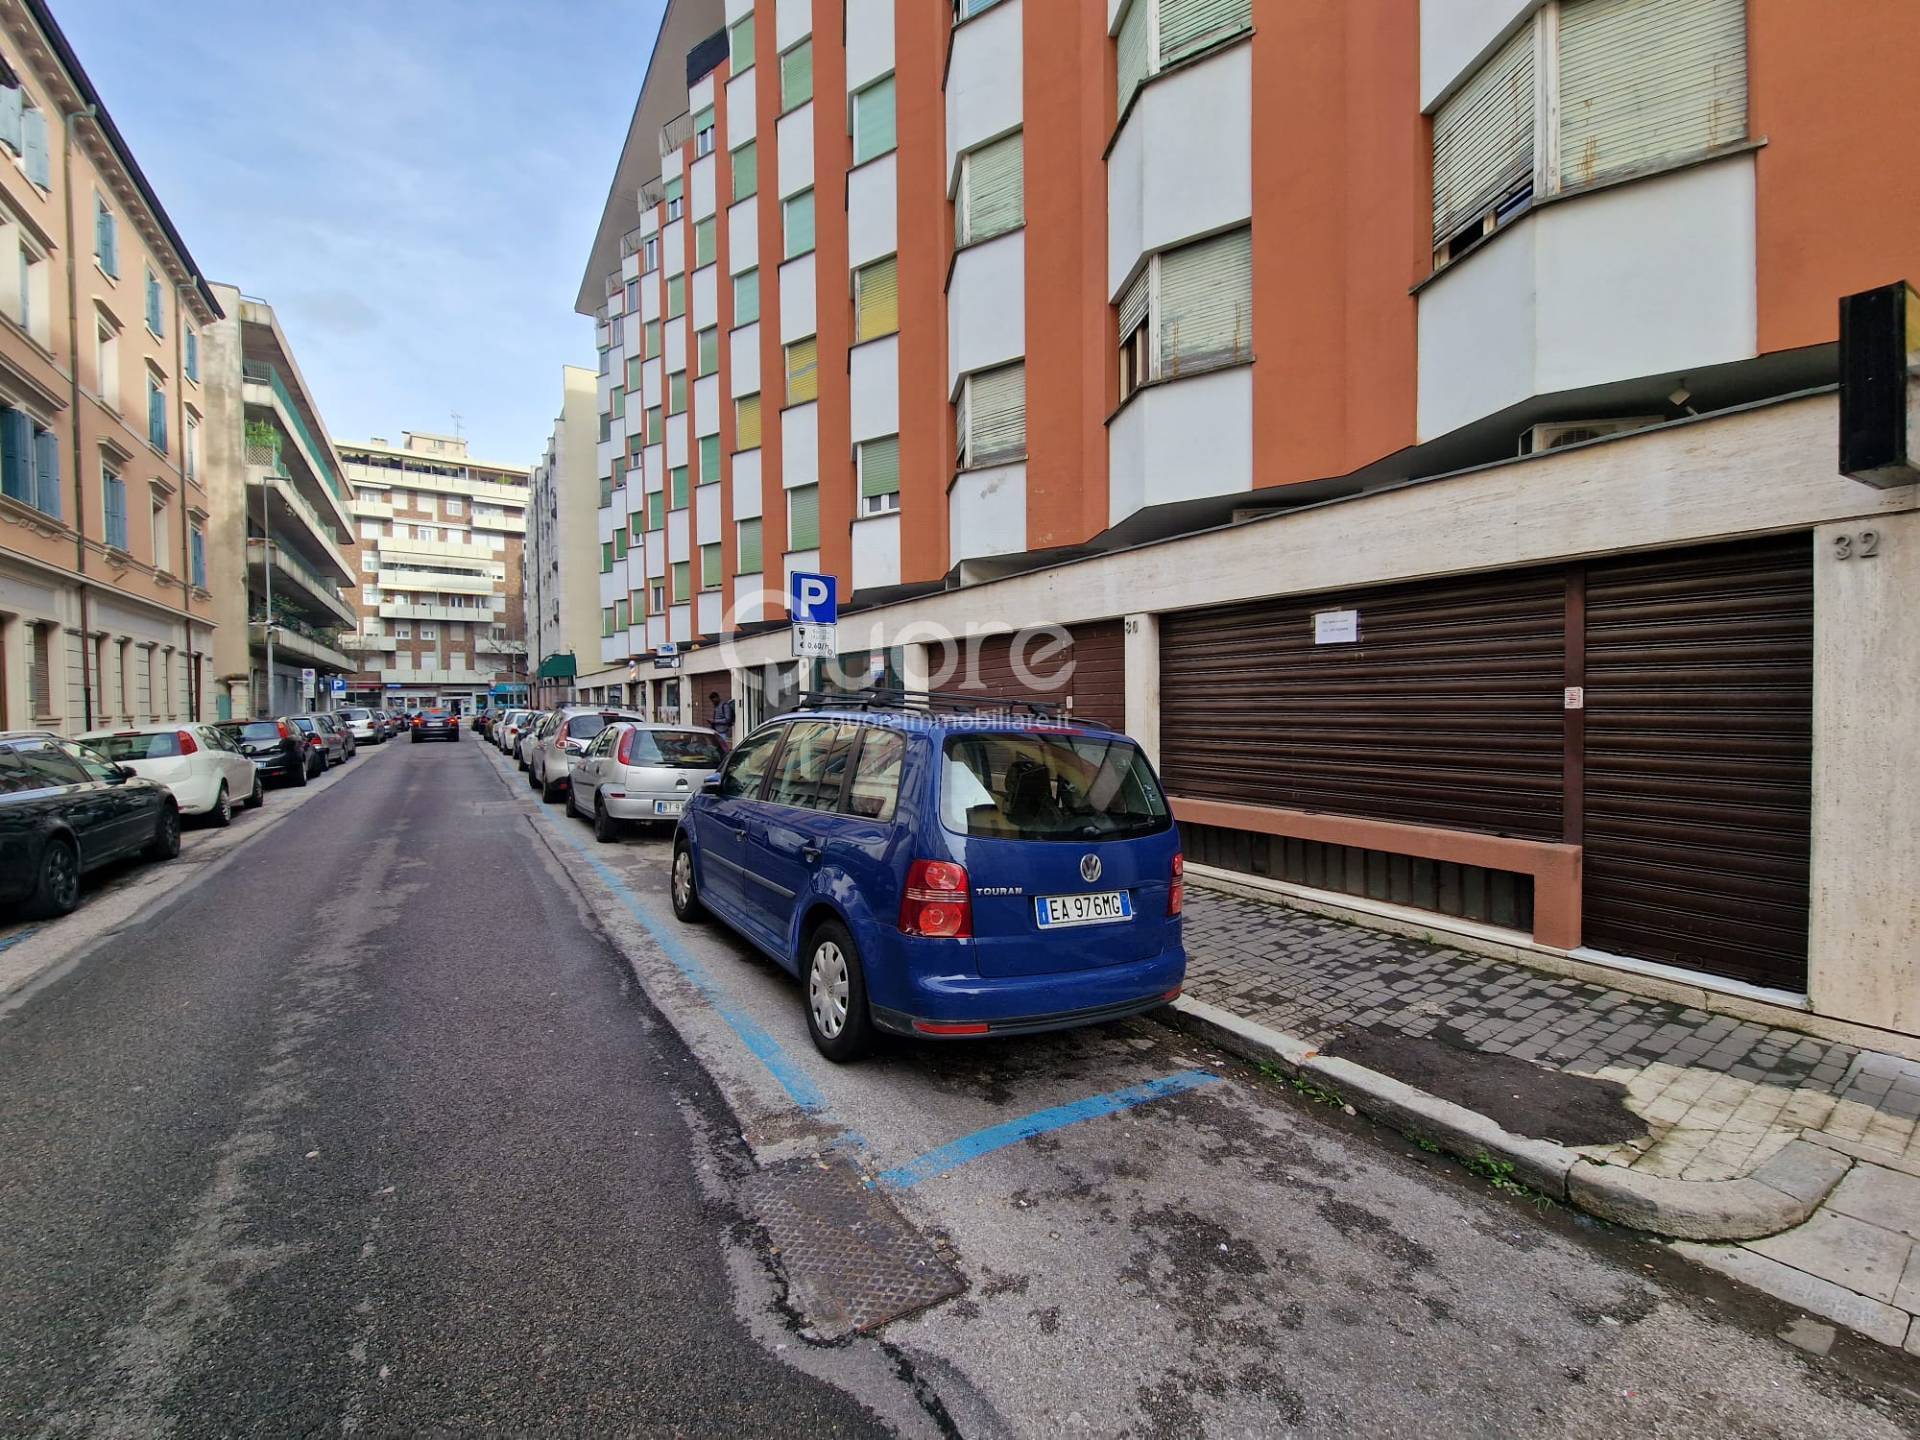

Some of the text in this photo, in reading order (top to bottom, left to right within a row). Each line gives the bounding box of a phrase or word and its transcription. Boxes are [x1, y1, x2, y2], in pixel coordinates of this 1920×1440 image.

[1834, 529, 1879, 561] 32
[800, 577, 829, 618] P
[333, 680, 343, 690] P
[976, 887, 1023, 895] TOURAN
[1049, 899, 1070, 921] EA
[1074, 895, 1120, 918] 976MG
